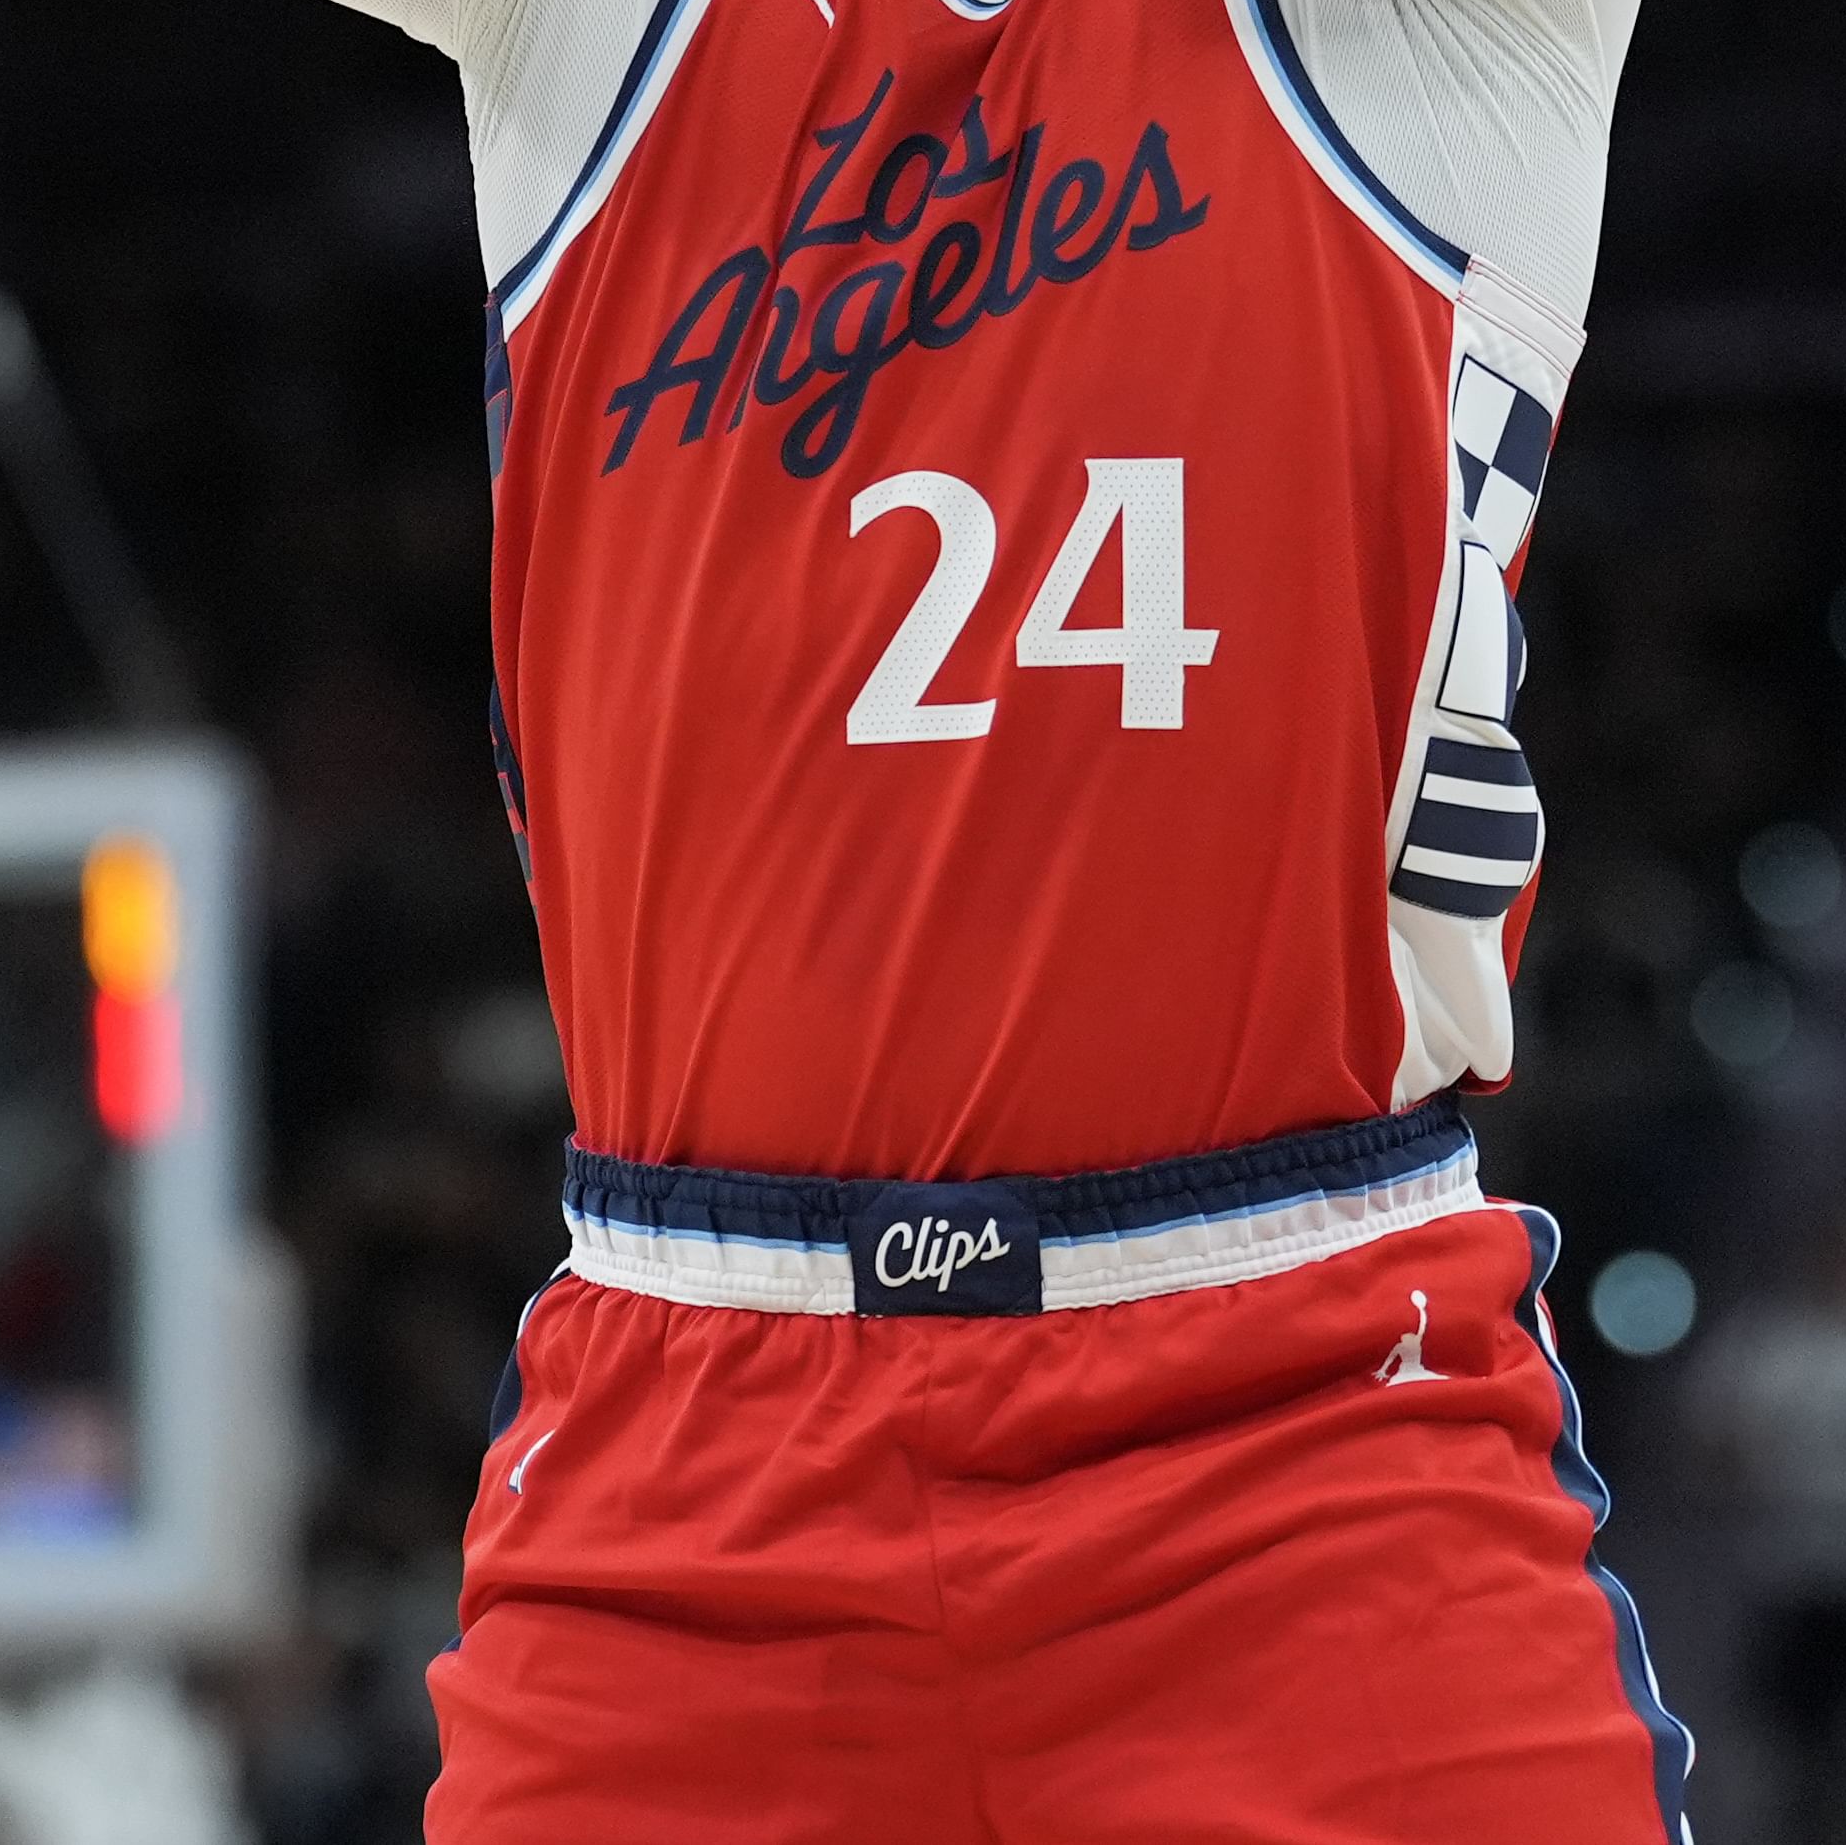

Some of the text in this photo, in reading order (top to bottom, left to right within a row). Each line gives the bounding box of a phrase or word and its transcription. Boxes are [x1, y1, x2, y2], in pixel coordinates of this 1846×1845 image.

[777, 67, 1012, 265] Los
[846, 457, 1220, 746] 24
[874, 1215, 1011, 1293] Clips
